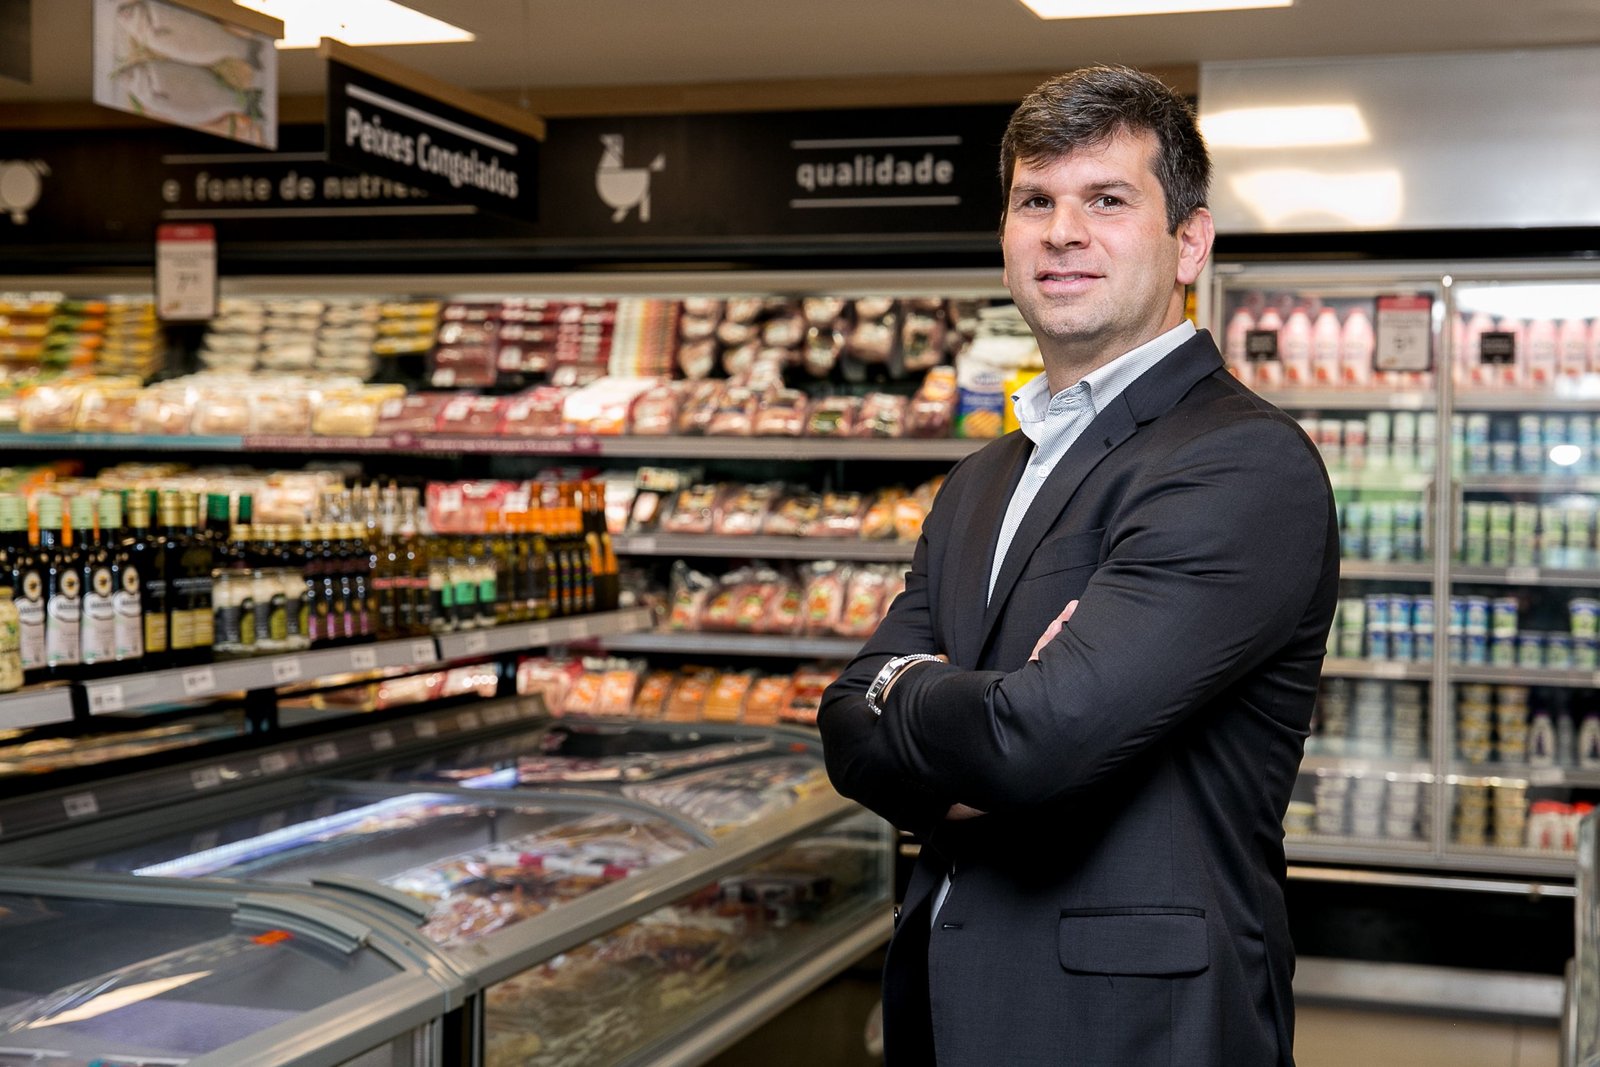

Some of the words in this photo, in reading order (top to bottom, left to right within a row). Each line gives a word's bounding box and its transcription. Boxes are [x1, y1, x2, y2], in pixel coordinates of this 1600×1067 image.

[346, 106, 414, 166] Peixes
[417, 132, 519, 199] Congelados
[162, 179, 181, 202] e
[196, 171, 272, 201] fonte
[279, 170, 316, 201] de
[796, 153, 954, 192] qualidade
